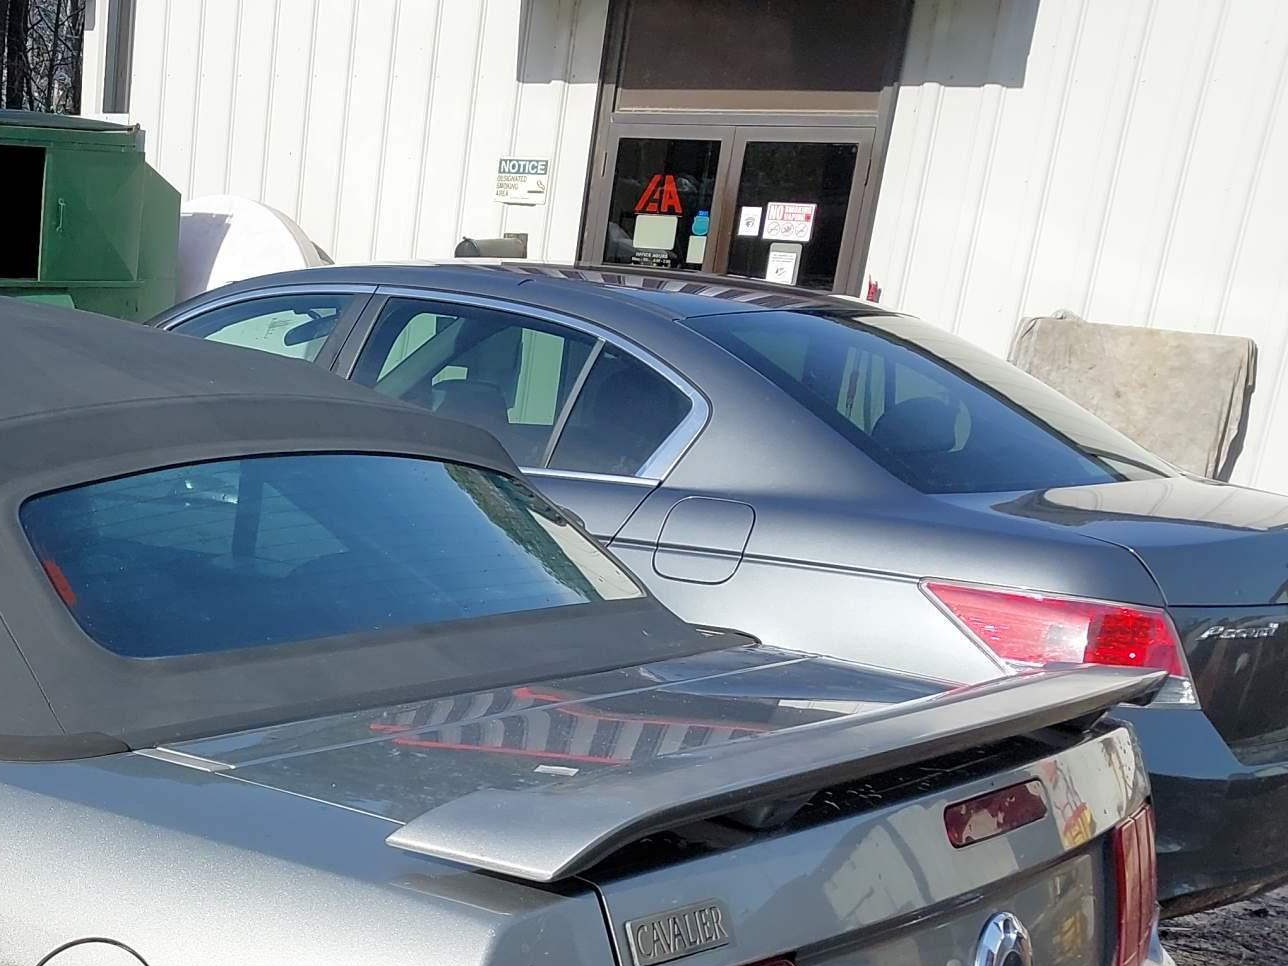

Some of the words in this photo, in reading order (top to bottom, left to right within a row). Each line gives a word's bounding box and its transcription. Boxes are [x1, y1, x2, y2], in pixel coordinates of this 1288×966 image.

[500, 160, 547, 173] NOTICE
[768, 205, 784, 220] NO
[637, 906, 728, 958] CAVALIER
